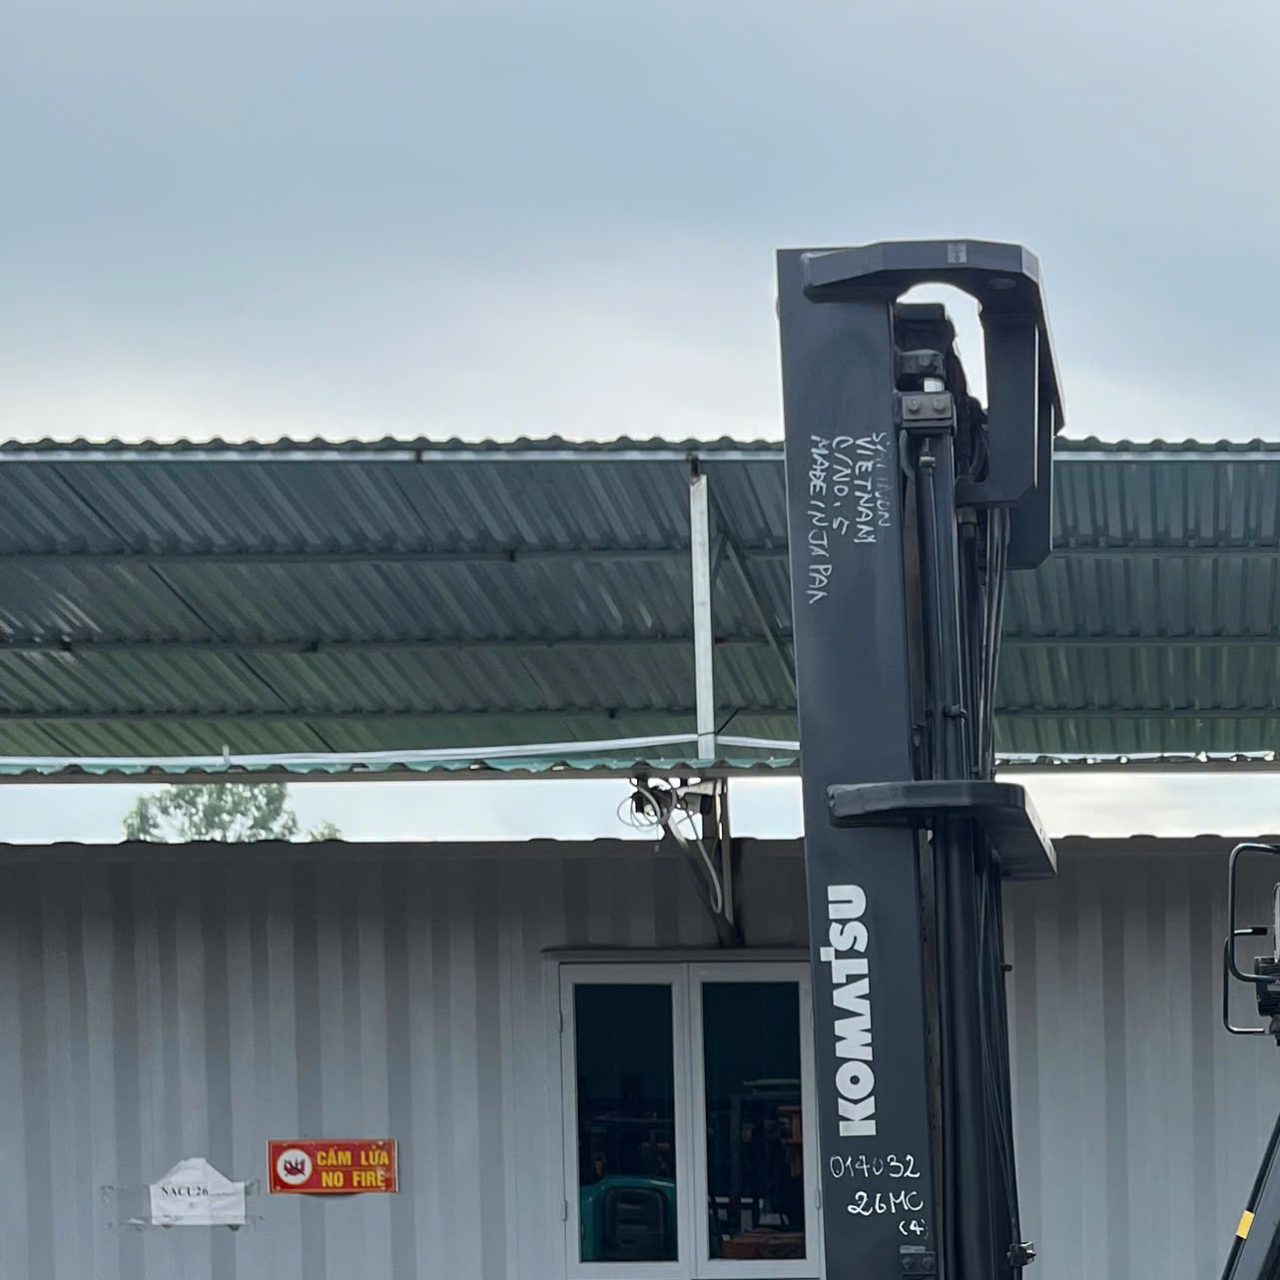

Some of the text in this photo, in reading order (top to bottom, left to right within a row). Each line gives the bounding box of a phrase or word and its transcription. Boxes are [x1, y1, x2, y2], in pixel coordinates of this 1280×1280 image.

[809, 434, 830, 496] MADE
[853, 437, 876, 543] VIETNAM
[807, 500, 829, 526] IN
[833, 516, 850, 535] 5
[820, 884, 876, 1137] KOMATSU
[322, 1170, 386, 1187] NO FIRE
